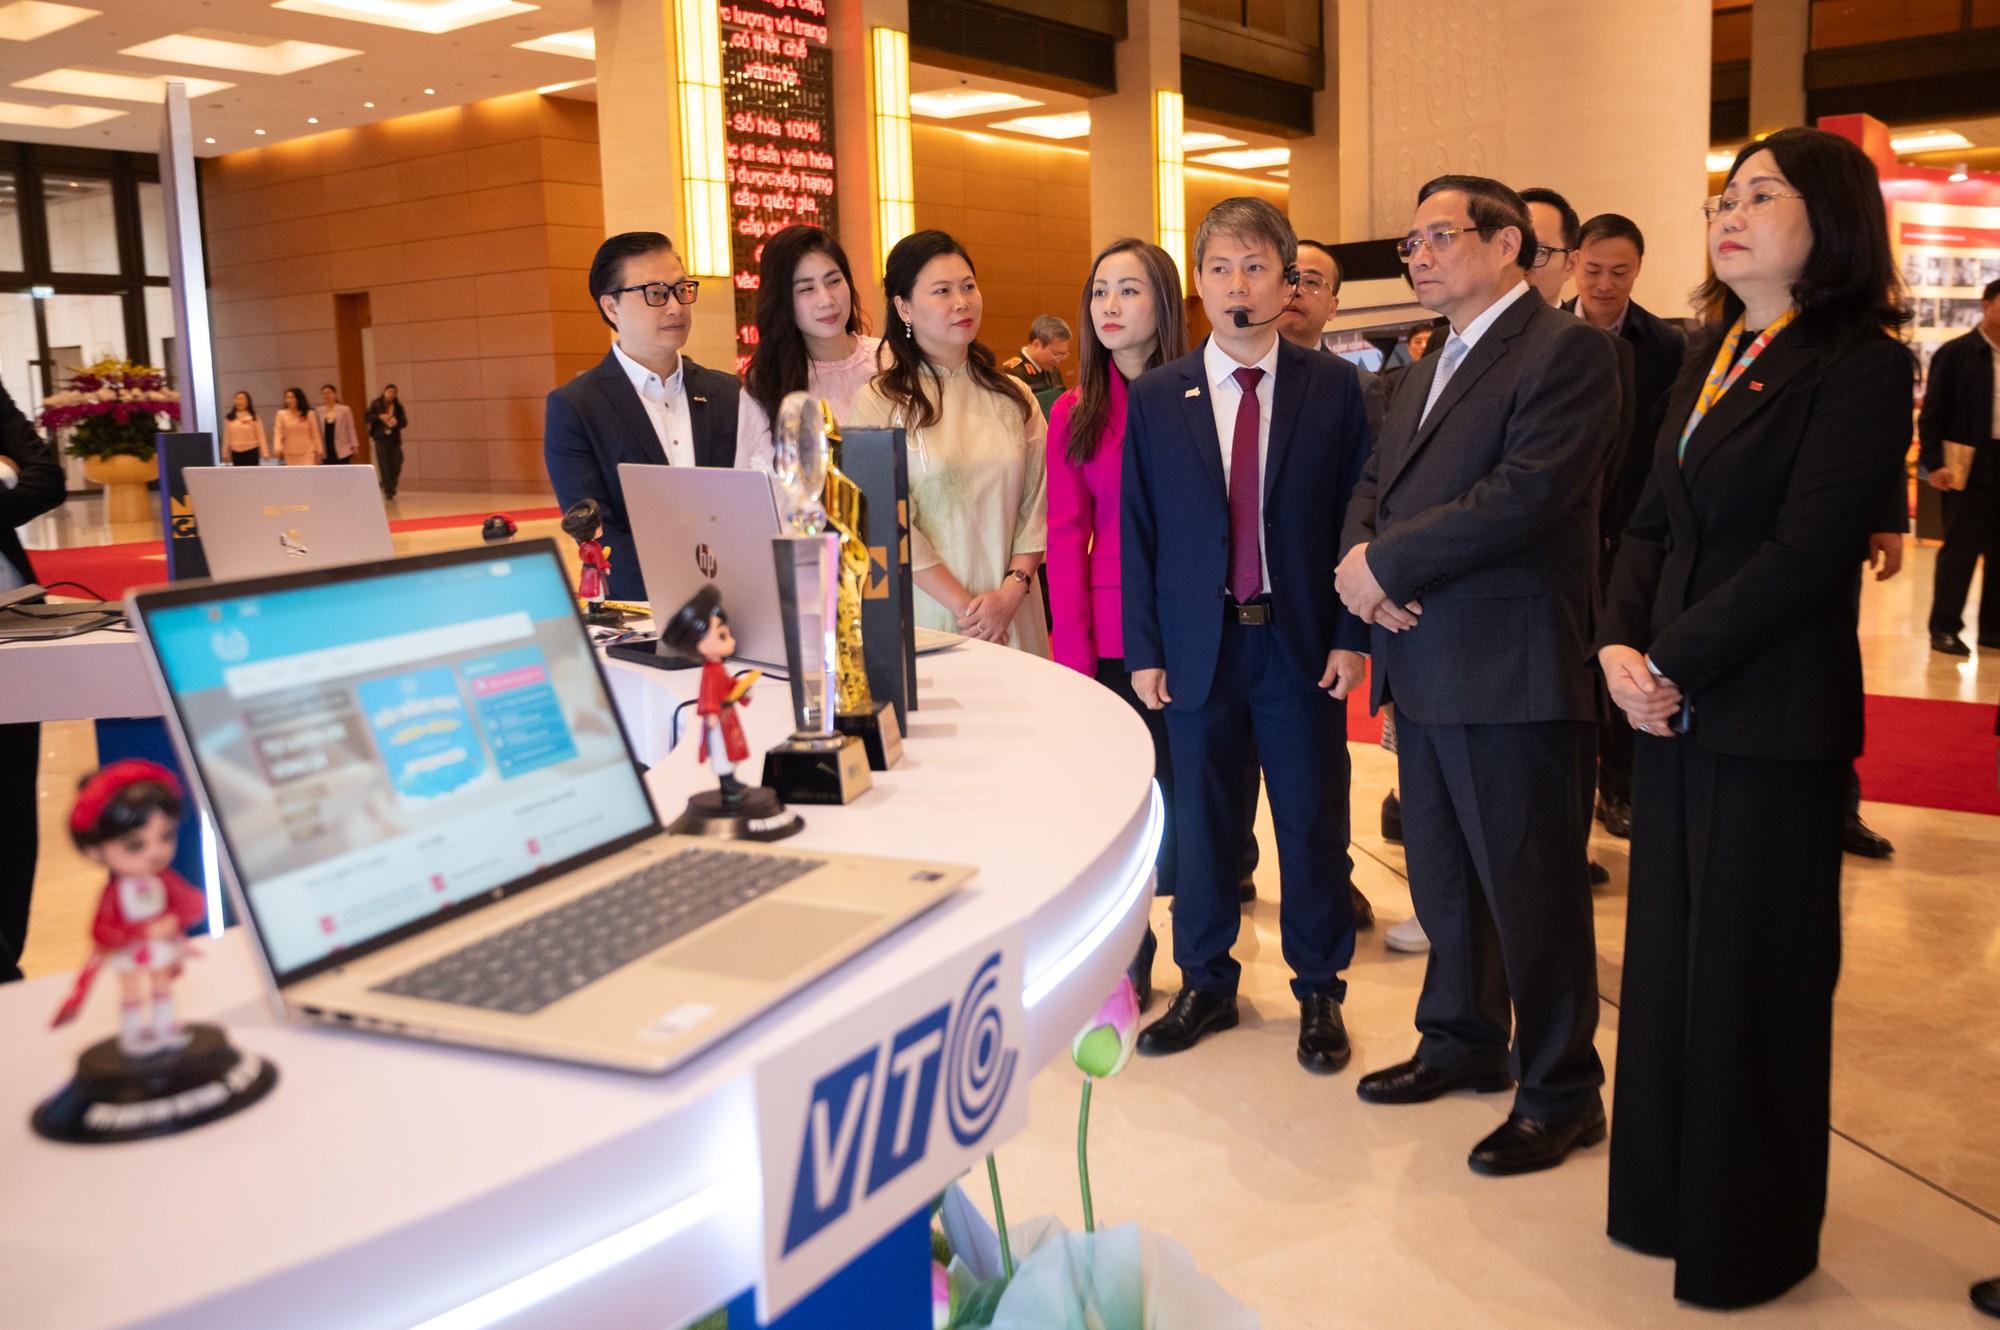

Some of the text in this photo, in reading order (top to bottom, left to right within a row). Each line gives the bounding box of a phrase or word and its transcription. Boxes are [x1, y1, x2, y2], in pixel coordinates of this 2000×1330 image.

[732, 5, 774, 34] lượng
[793, 18, 828, 44] trang
[731, 30, 750, 48] có
[733, 111, 756, 133] Số
[756, 115, 782, 136] hóa
[783, 119, 820, 142] 100%
[780, 148, 807, 168] văn
[807, 150, 834, 170] hóa
[800, 171, 834, 196] hạng
[733, 185, 760, 211] cấp
[761, 188, 795, 213] quốc
[781, 950, 1018, 1258] VTC
